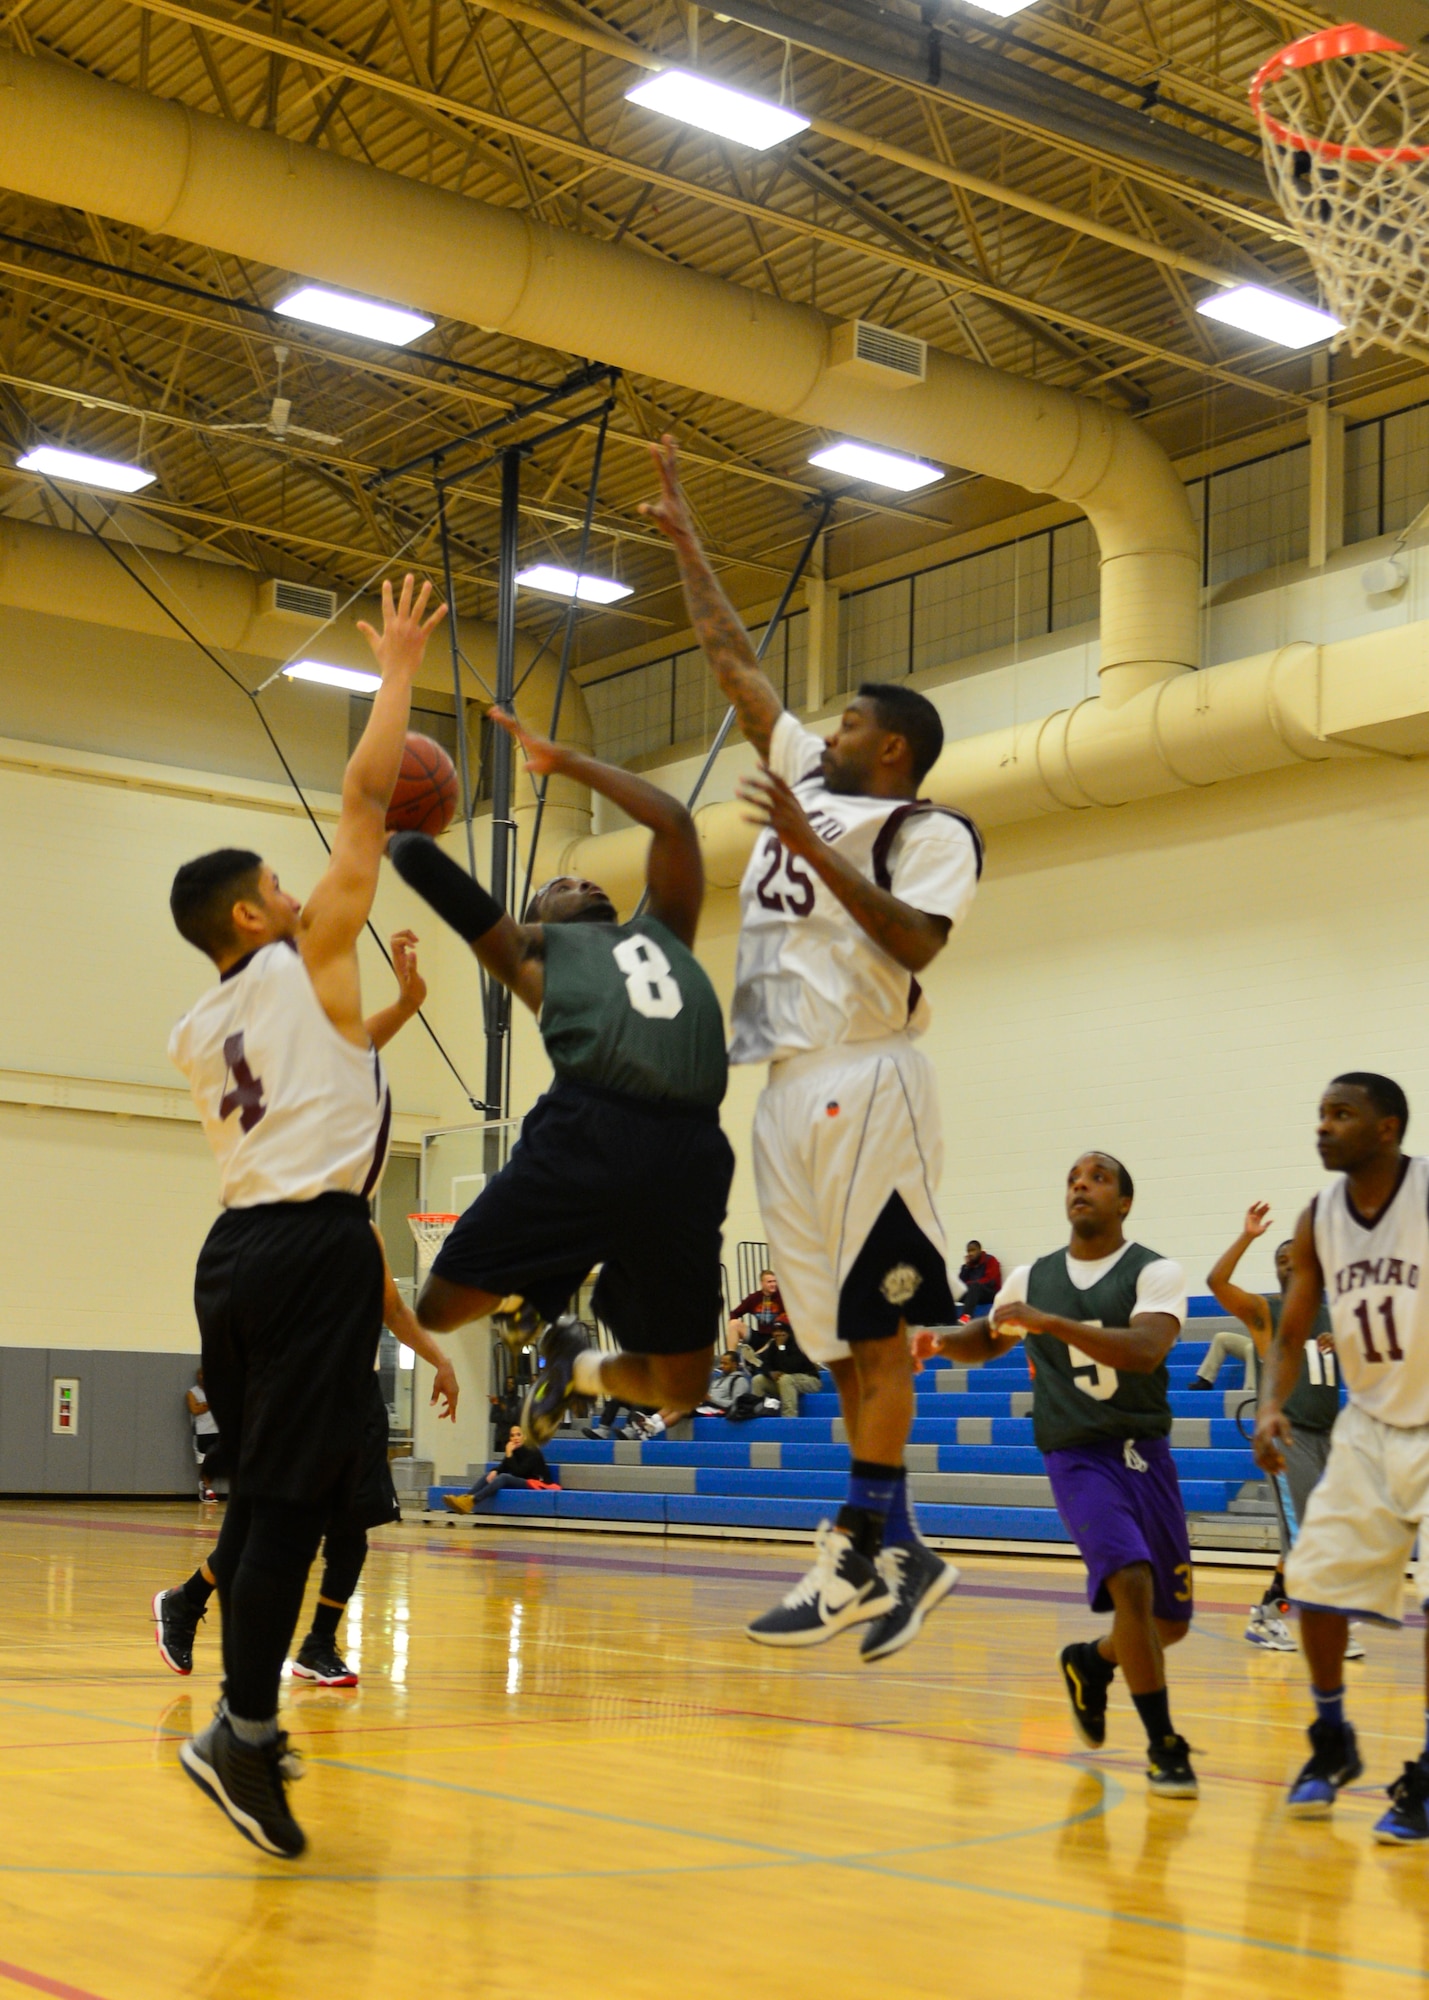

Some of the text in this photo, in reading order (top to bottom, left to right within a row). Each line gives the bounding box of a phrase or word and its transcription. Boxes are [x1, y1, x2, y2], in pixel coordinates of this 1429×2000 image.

[757, 836, 815, 918] 25
[612, 933, 684, 1020] 8
[218, 1030, 266, 1135] 4
[1067, 1319, 1119, 1401] 5
[1353, 1296, 1404, 1364] 11
[1174, 1563, 1193, 1602] 3
